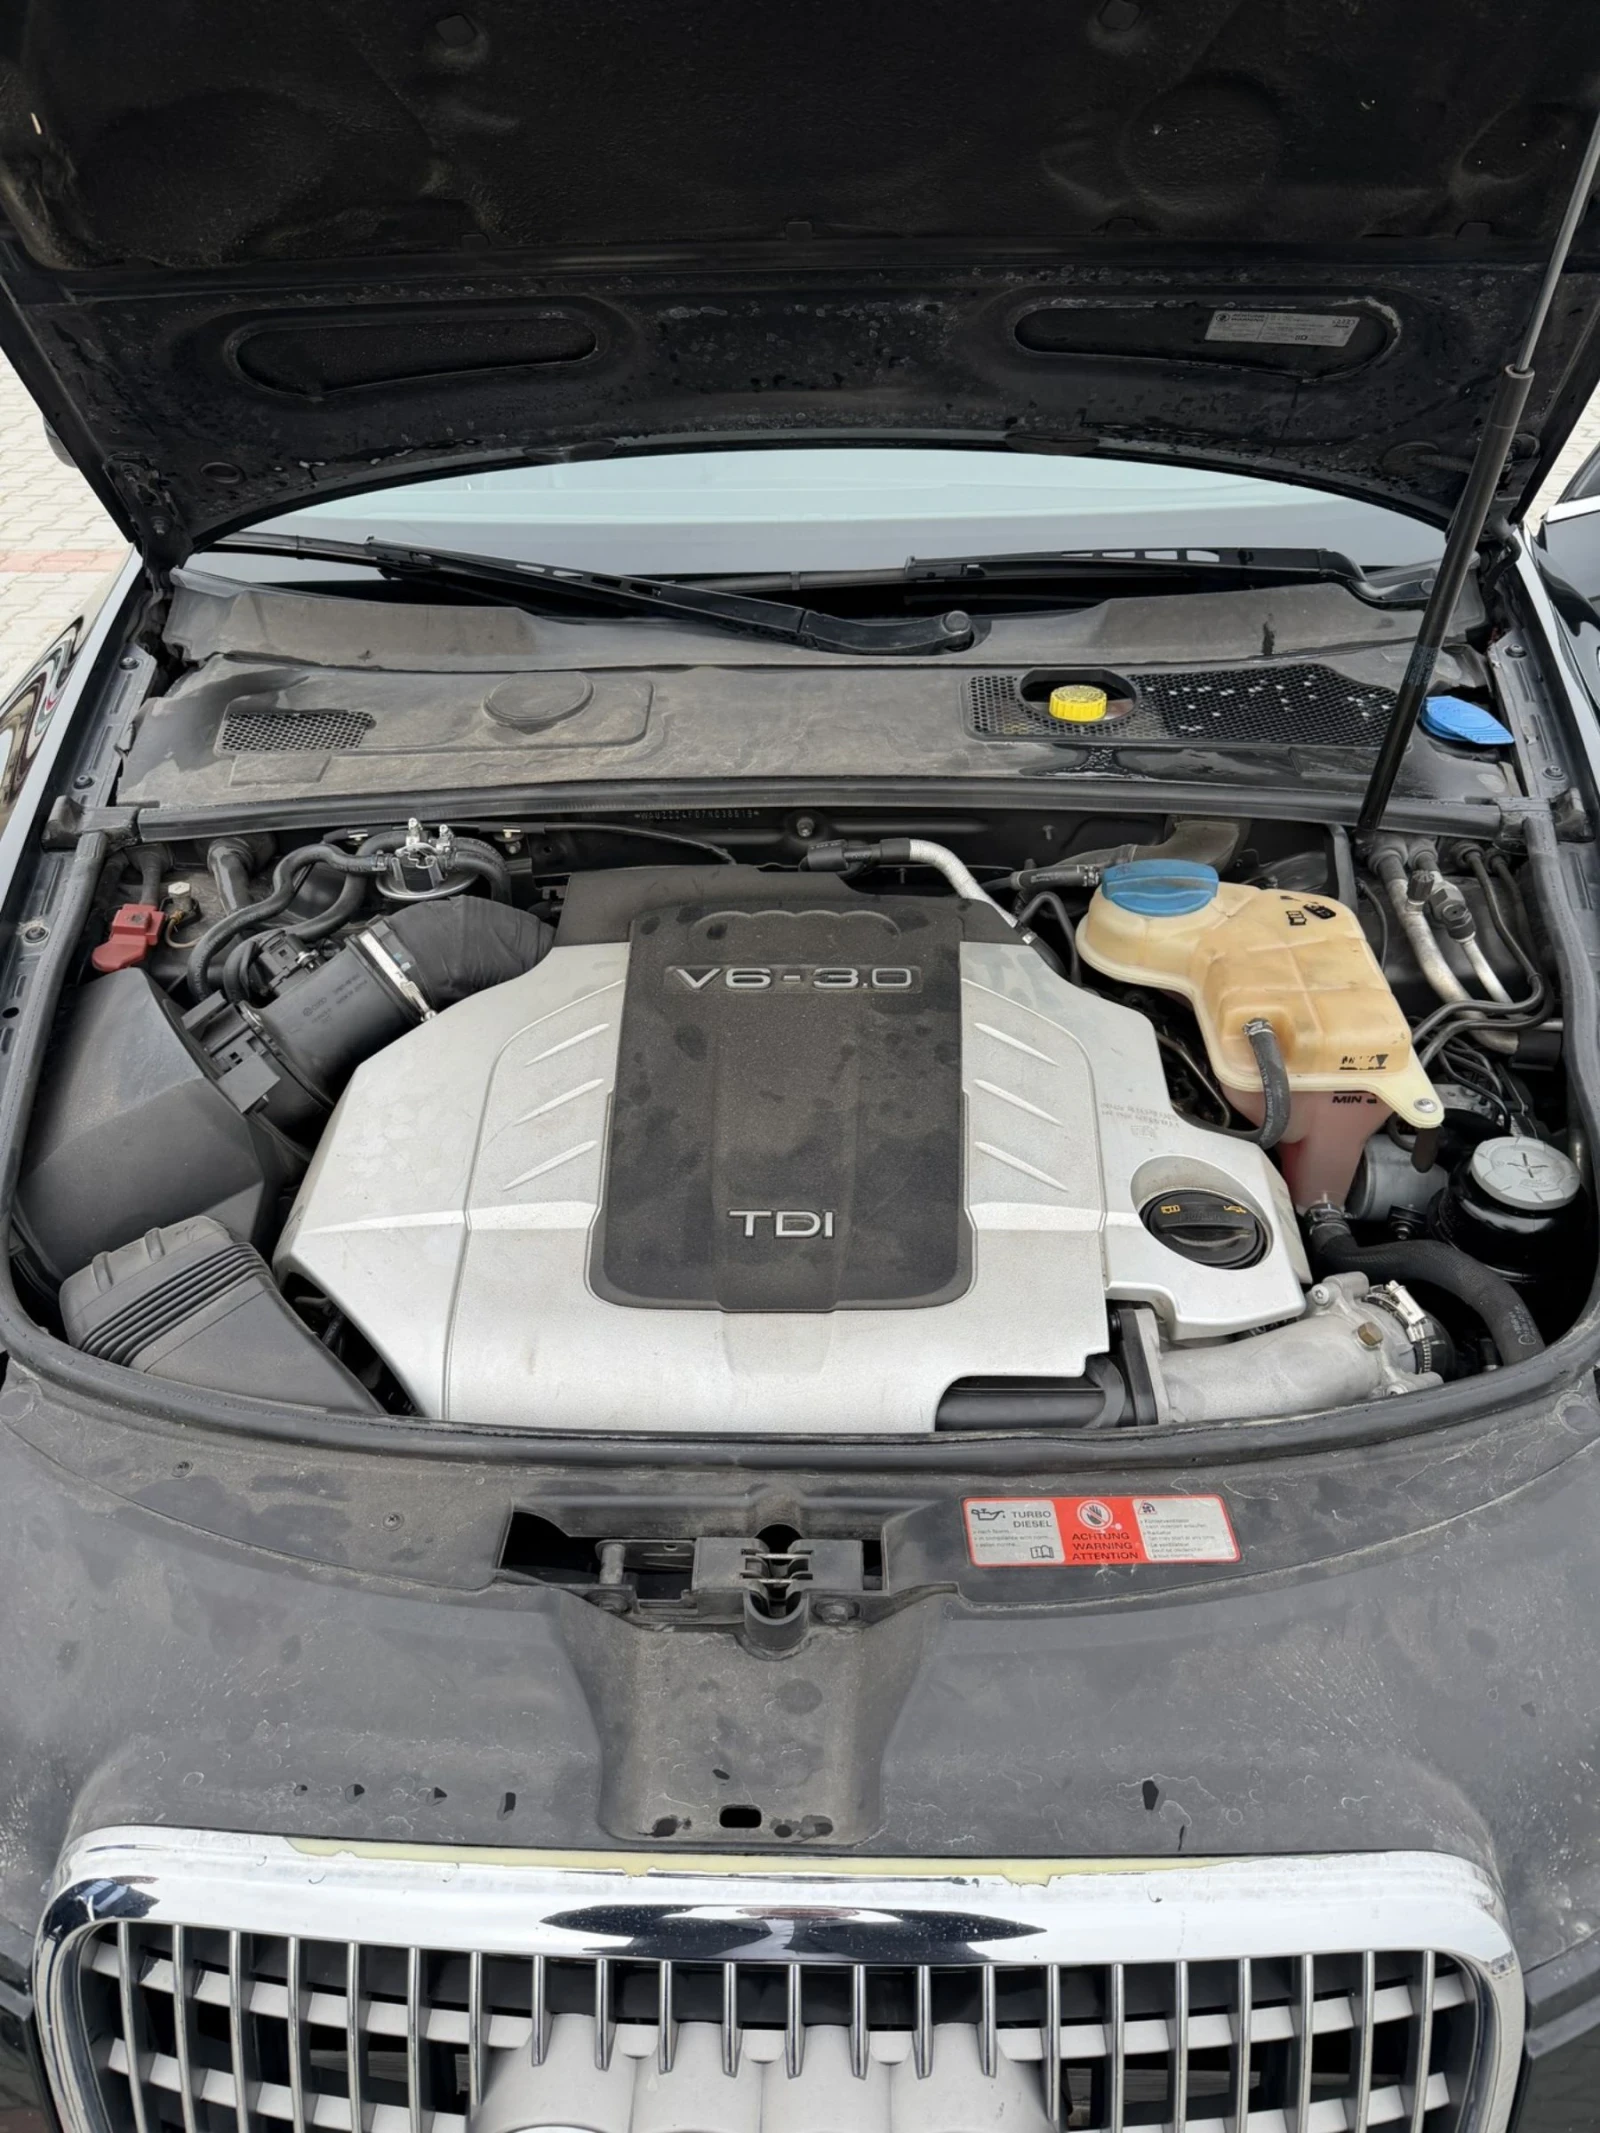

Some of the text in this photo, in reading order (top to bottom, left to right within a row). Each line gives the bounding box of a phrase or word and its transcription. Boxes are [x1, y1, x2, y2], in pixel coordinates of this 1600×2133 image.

[1332, 1095, 1362, 1104] MIN
[729, 1210, 834, 1238] TDI
[1011, 1510, 1052, 1519] TURBO
[1013, 1520, 1053, 1528] DIESEL
[1072, 1532, 1130, 1541] ACHTUNG
[1072, 1542, 1133, 1550] WARNING
[1072, 1552, 1138, 1560] ATTENTION
